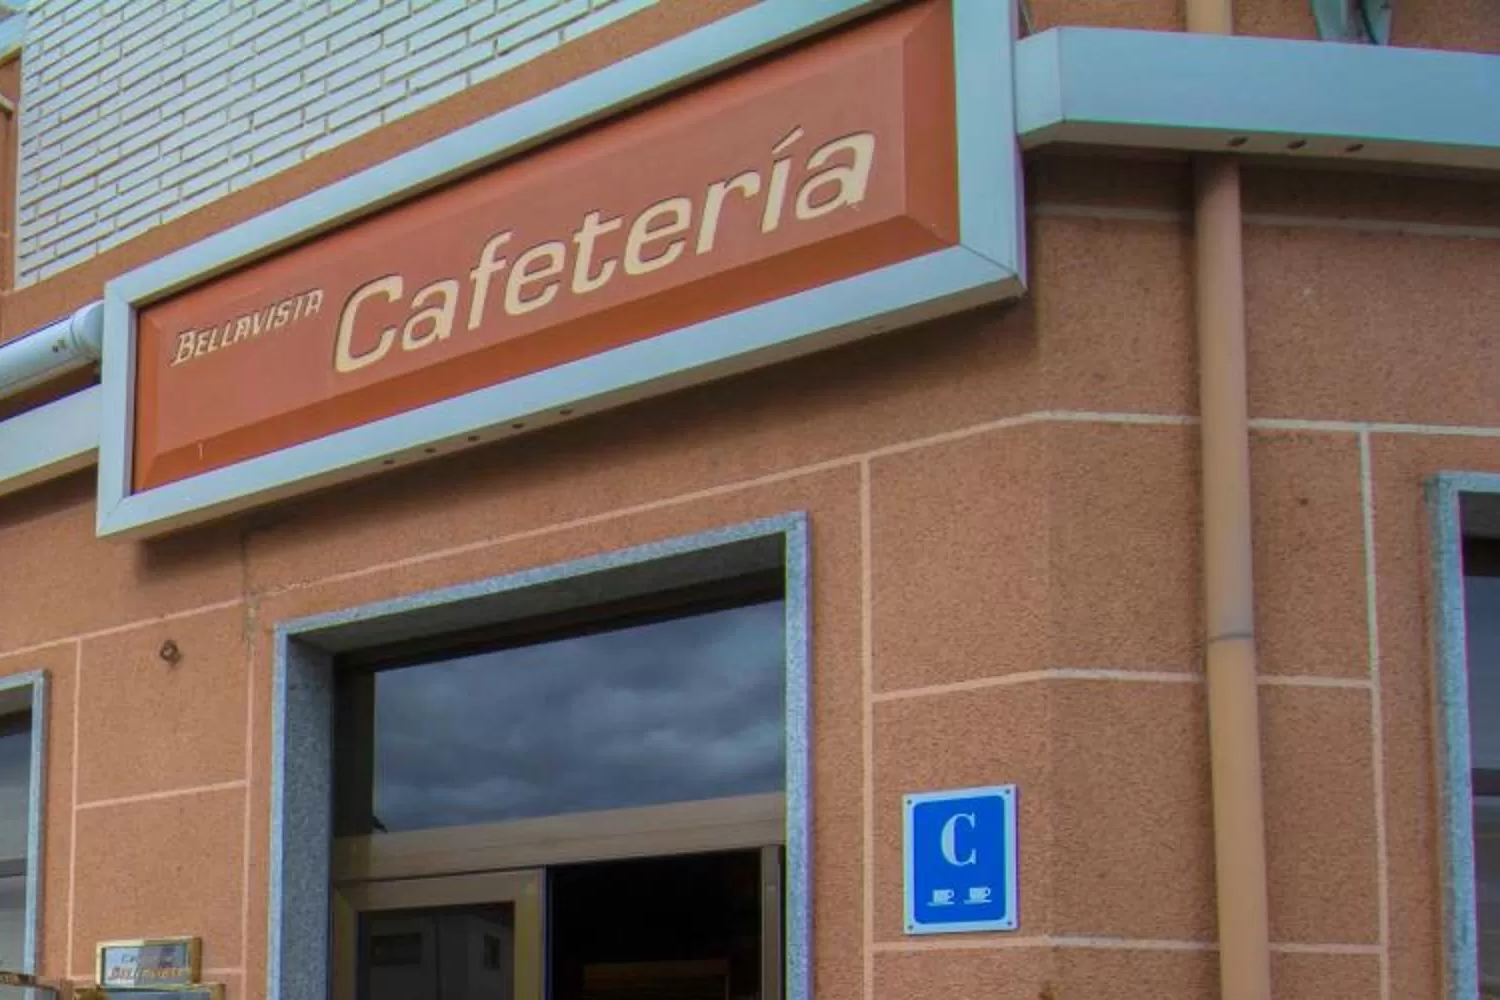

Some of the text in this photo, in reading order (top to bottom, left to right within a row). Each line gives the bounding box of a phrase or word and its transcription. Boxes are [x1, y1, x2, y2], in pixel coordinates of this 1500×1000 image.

[169, 126, 877, 374] BELLAVISTA Cafetería
[941, 813, 977, 866] C
